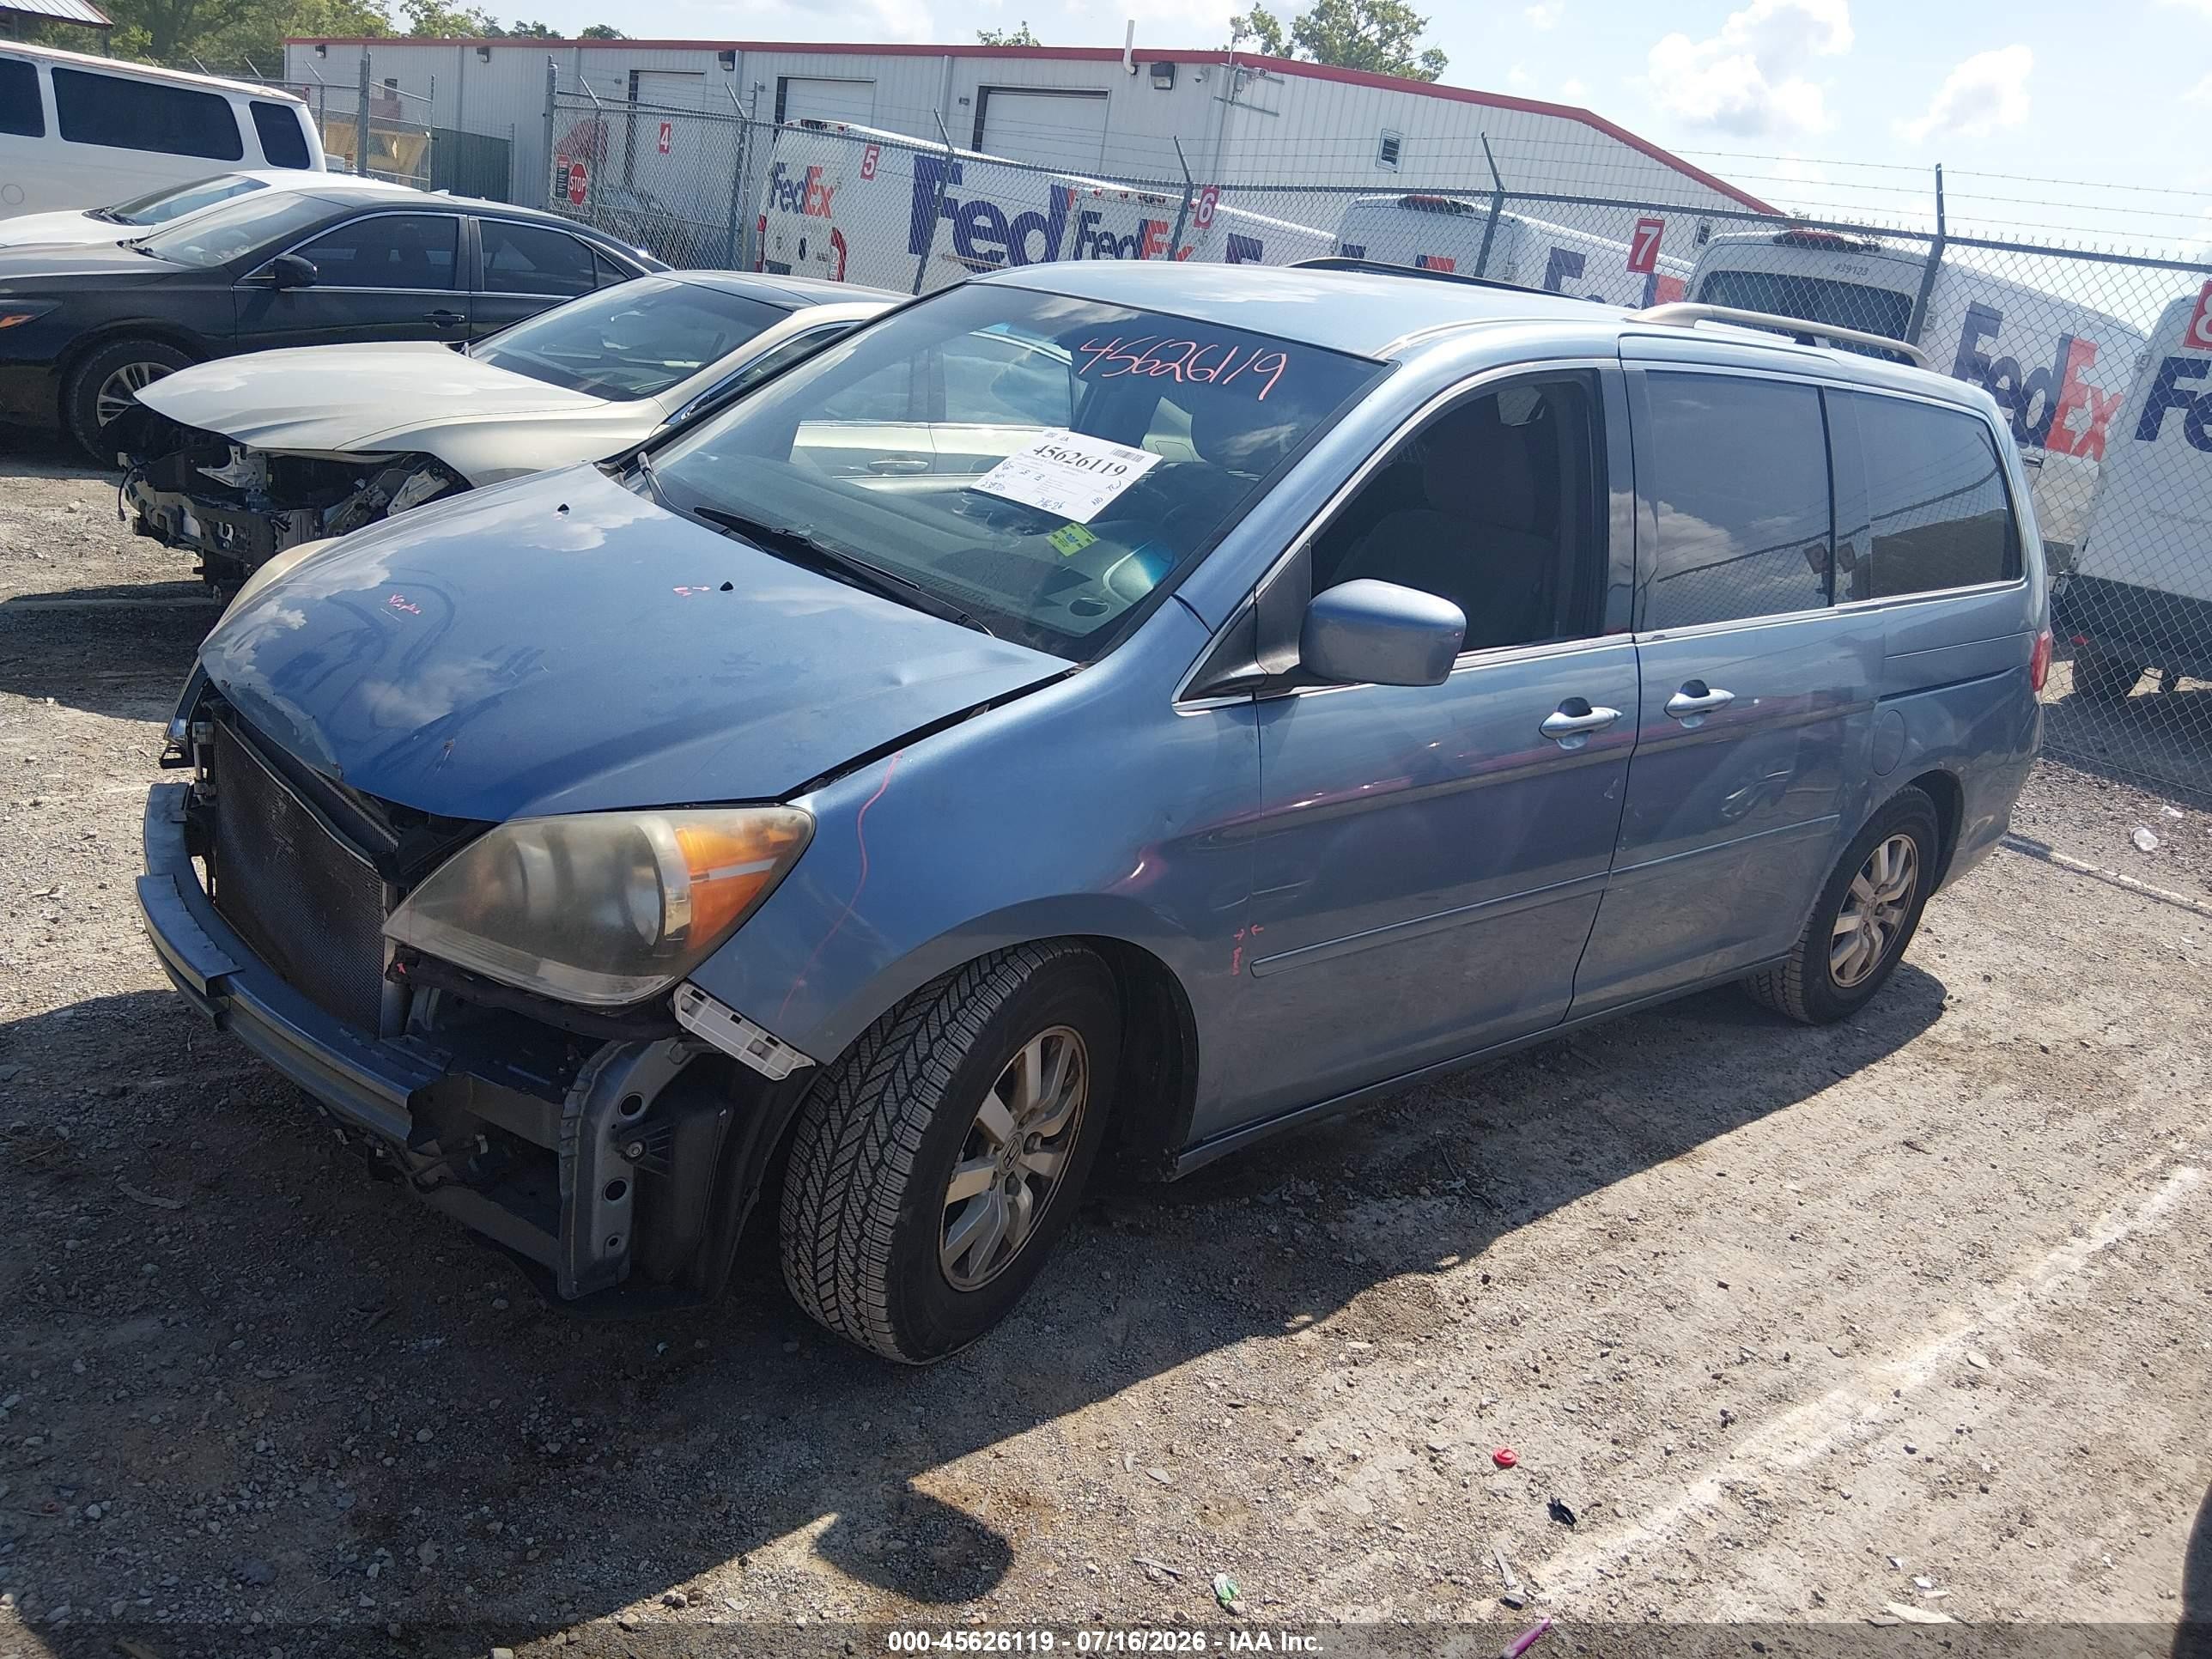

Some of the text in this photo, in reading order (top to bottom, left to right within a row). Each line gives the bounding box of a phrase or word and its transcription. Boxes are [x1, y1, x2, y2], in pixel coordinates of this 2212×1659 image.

[660, 127, 669, 149] 4
[864, 150, 877, 175] 5
[569, 176, 586, 192] STOP
[769, 162, 835, 219] FedEx
[1199, 192, 1215, 222] 6
[1635, 226, 1661, 265] 7
[1079, 336, 1286, 400] 45626119
[1033, 445, 1128, 477] 45626119
